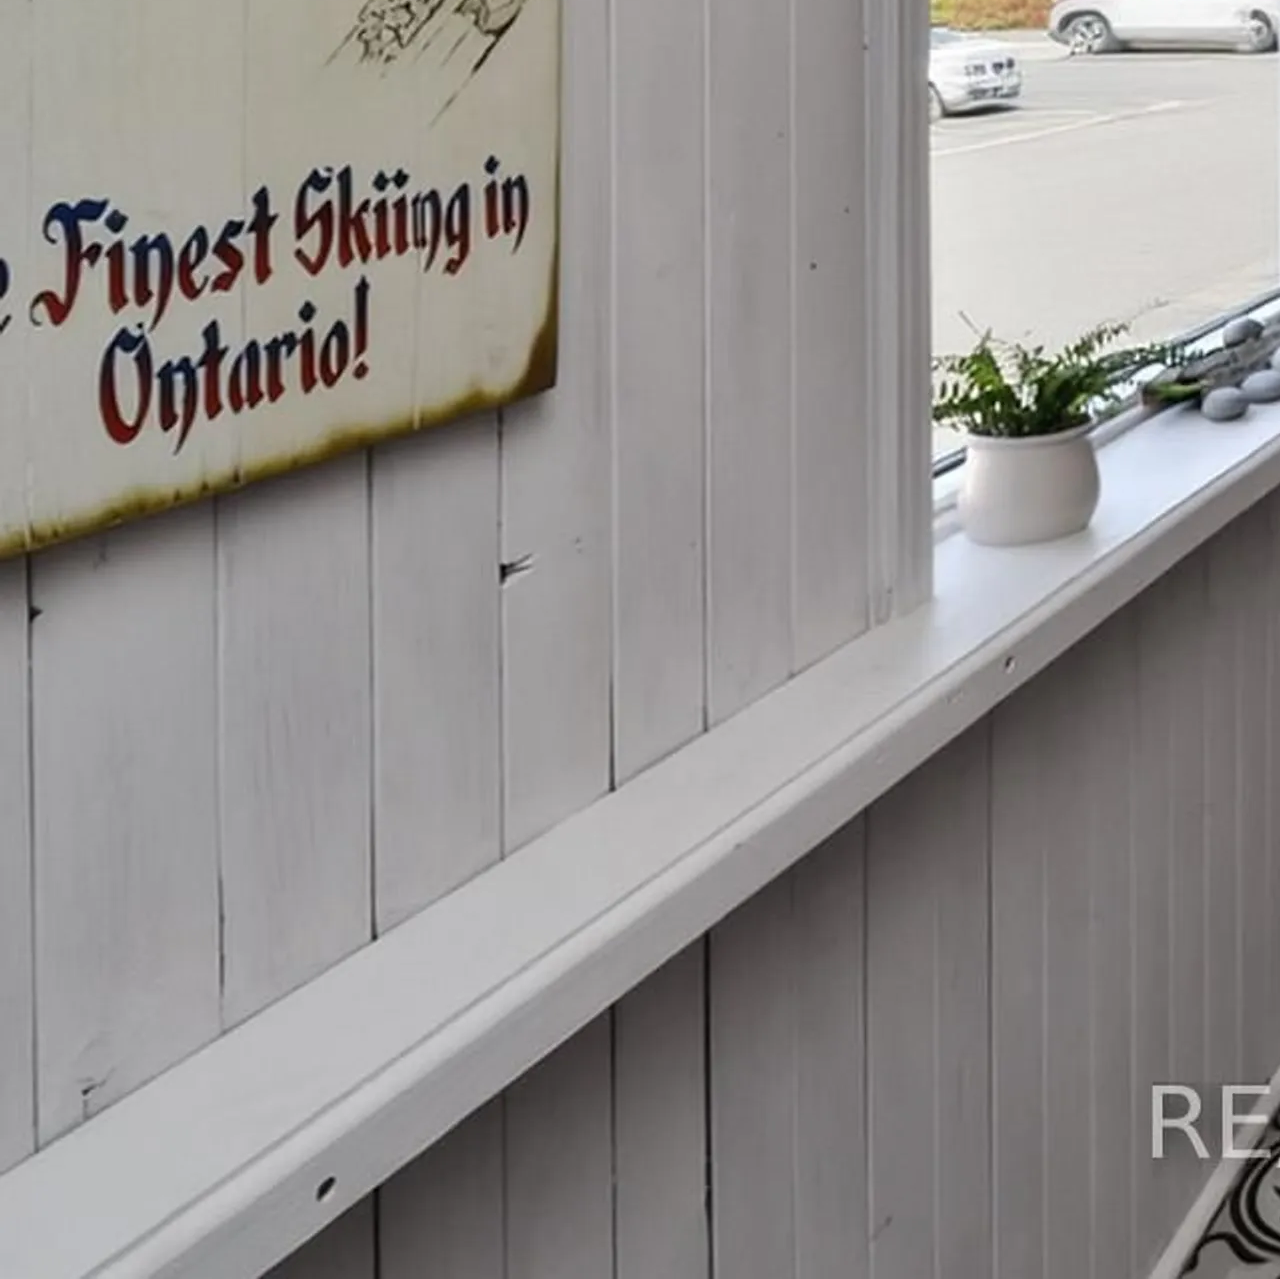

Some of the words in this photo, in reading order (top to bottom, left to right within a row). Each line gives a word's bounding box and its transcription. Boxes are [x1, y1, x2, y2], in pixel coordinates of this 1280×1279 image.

[30, 185, 280, 333] Finest
[294, 165, 471, 275] Skiing
[483, 155, 530, 253] in
[99, 276, 370, 455] Ontario!
